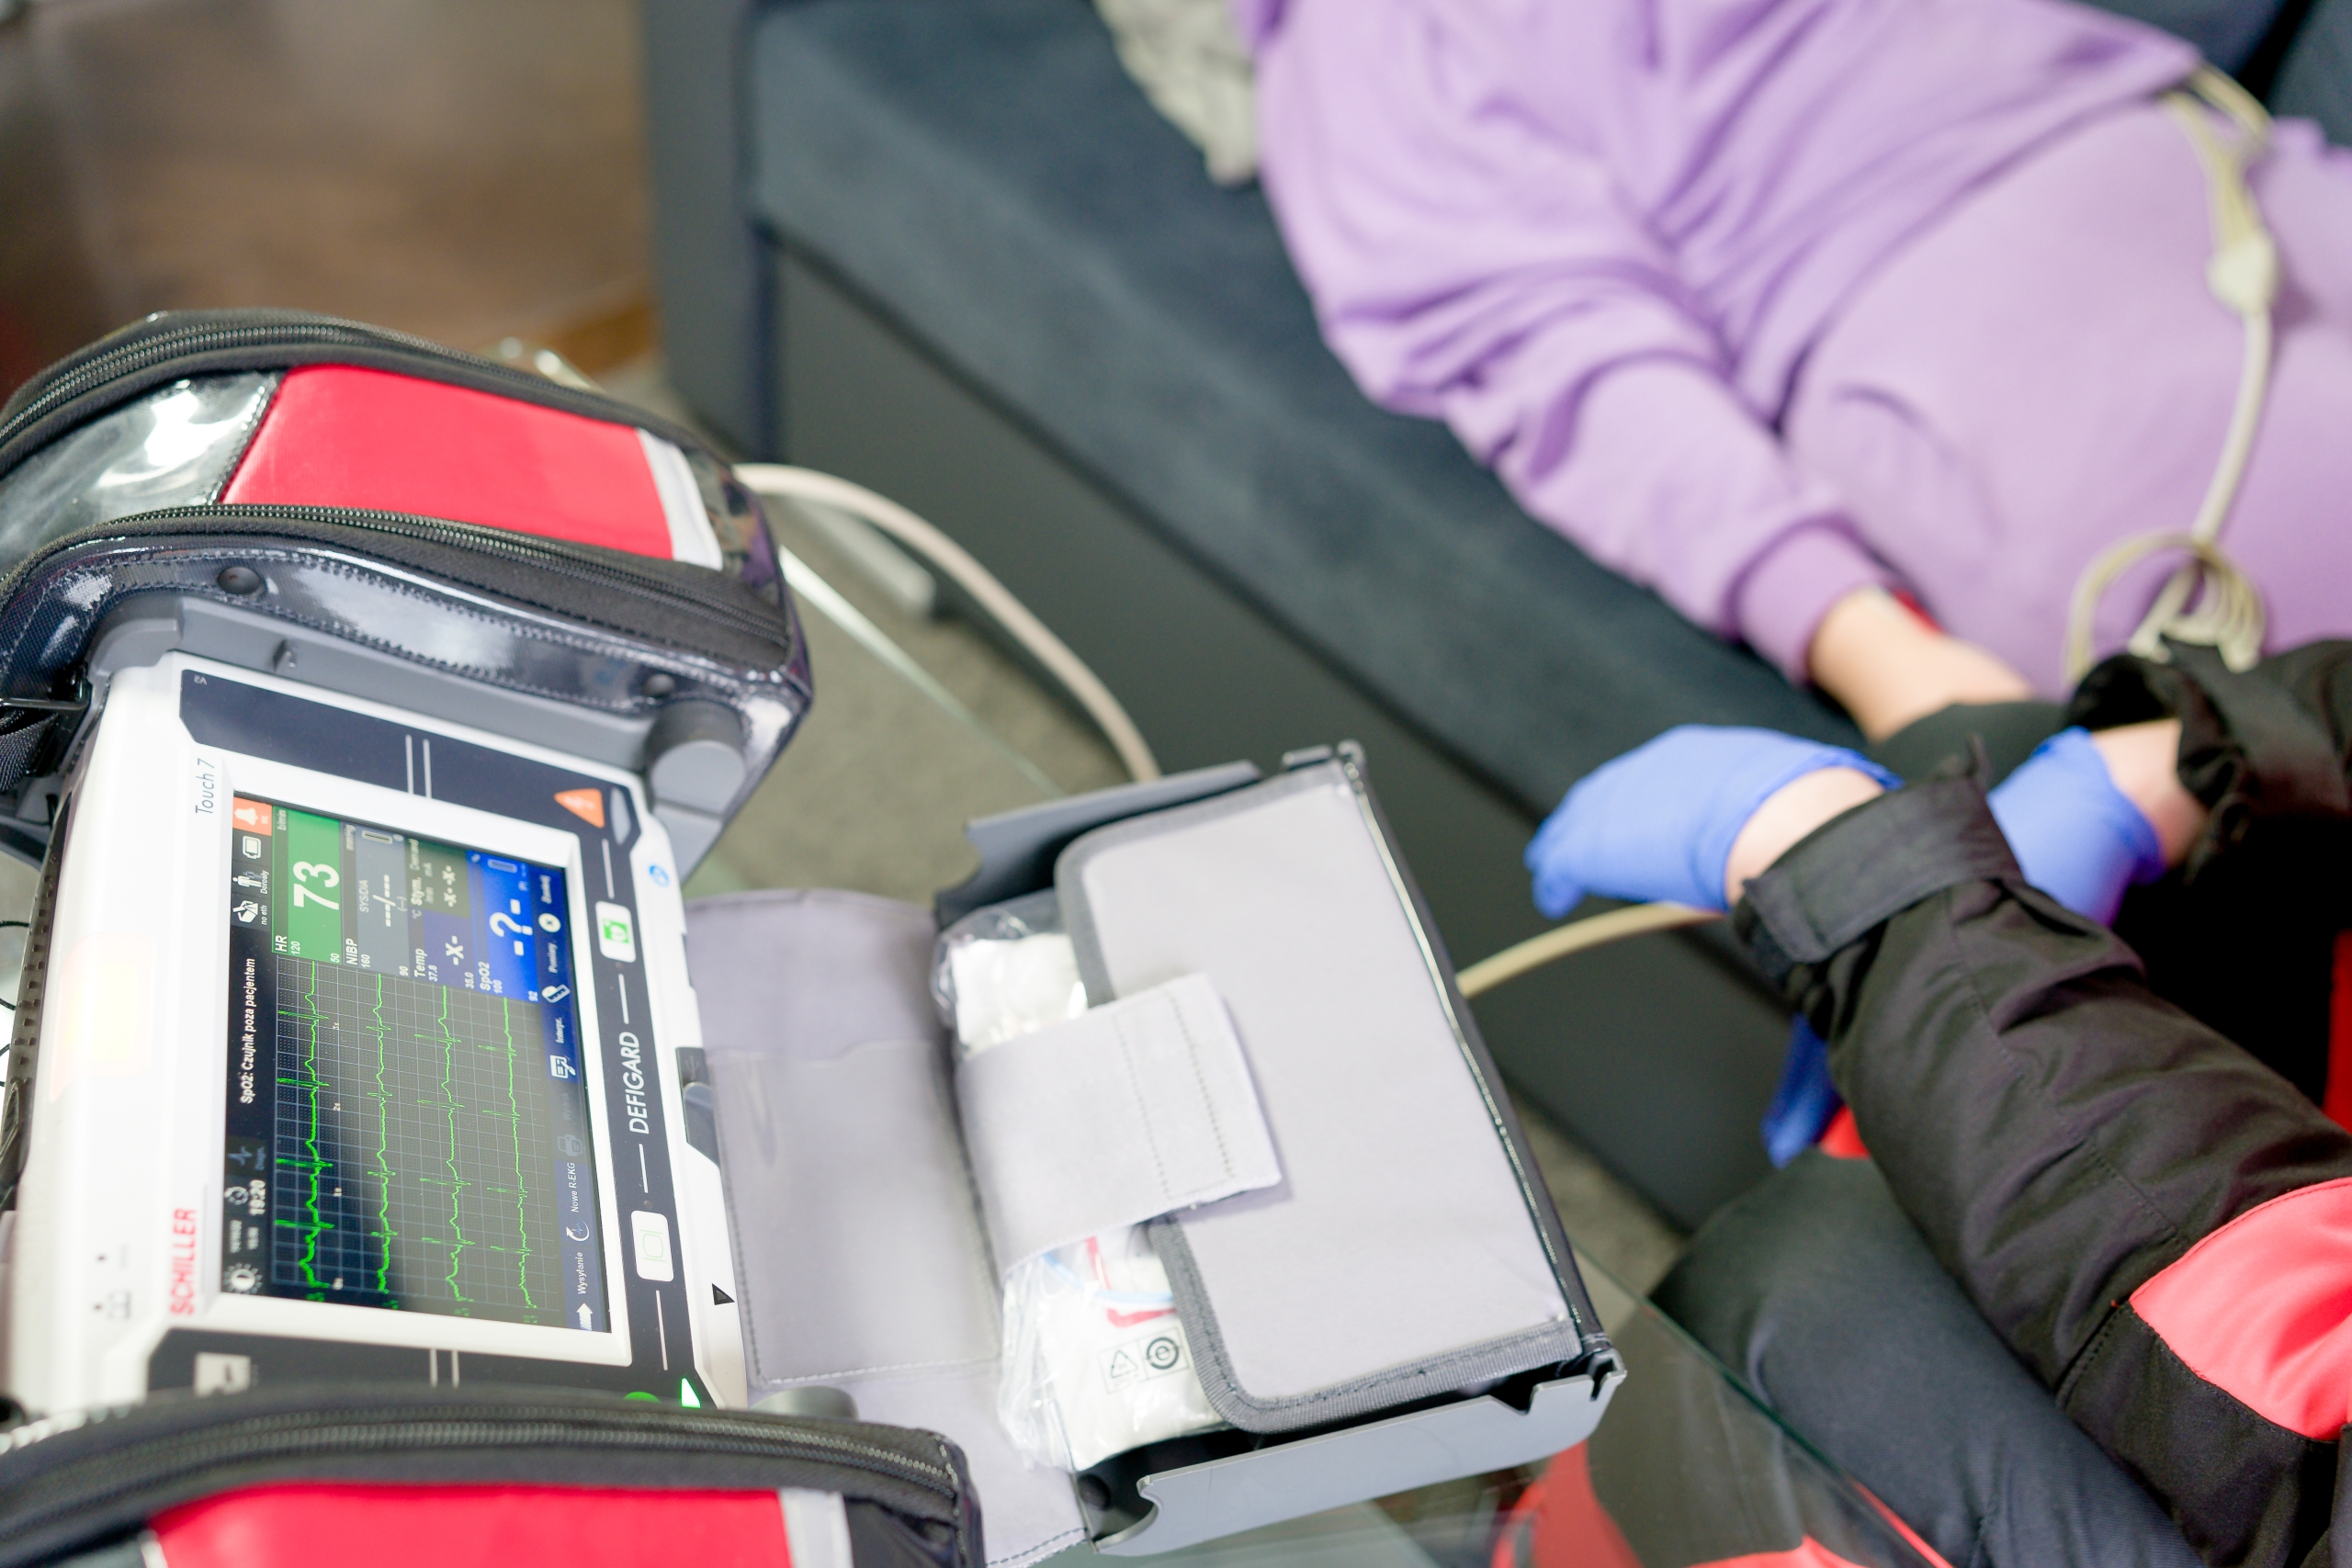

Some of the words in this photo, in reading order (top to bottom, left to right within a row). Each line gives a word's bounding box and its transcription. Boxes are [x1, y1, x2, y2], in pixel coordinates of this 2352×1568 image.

[197, 757, 215, 769] 7
[195, 772, 215, 814] Touch
[292, 861, 340, 910] 73
[411, 877, 424, 907] Stym.
[261, 916, 268, 926] no
[275, 935, 288, 953] HR
[290, 941, 300, 955] 120
[345, 938, 358, 965] NIBP
[330, 953, 340, 964] 50
[360, 954, 371, 969] 160
[399, 965, 409, 976] 90
[414, 948, 427, 977] Temp
[243, 958, 257, 1008] pacjentem
[428, 964, 438, 983] 37.8
[464, 972, 474, 989] 35.0
[478, 961, 492, 991] SpO2
[492, 979, 503, 995] 100
[243, 1010, 257, 1032] poza
[241, 1032, 257, 1071] Czujnik
[240, 1072, 256, 1104] SpO2:
[618, 1031, 650, 1134] DEFIGARD
[567, 1162, 578, 1189] R-EKG
[248, 1179, 266, 1216] 19:20
[571, 1190, 580, 1213] Nowe
[169, 1208, 197, 1316] SCHILLER
